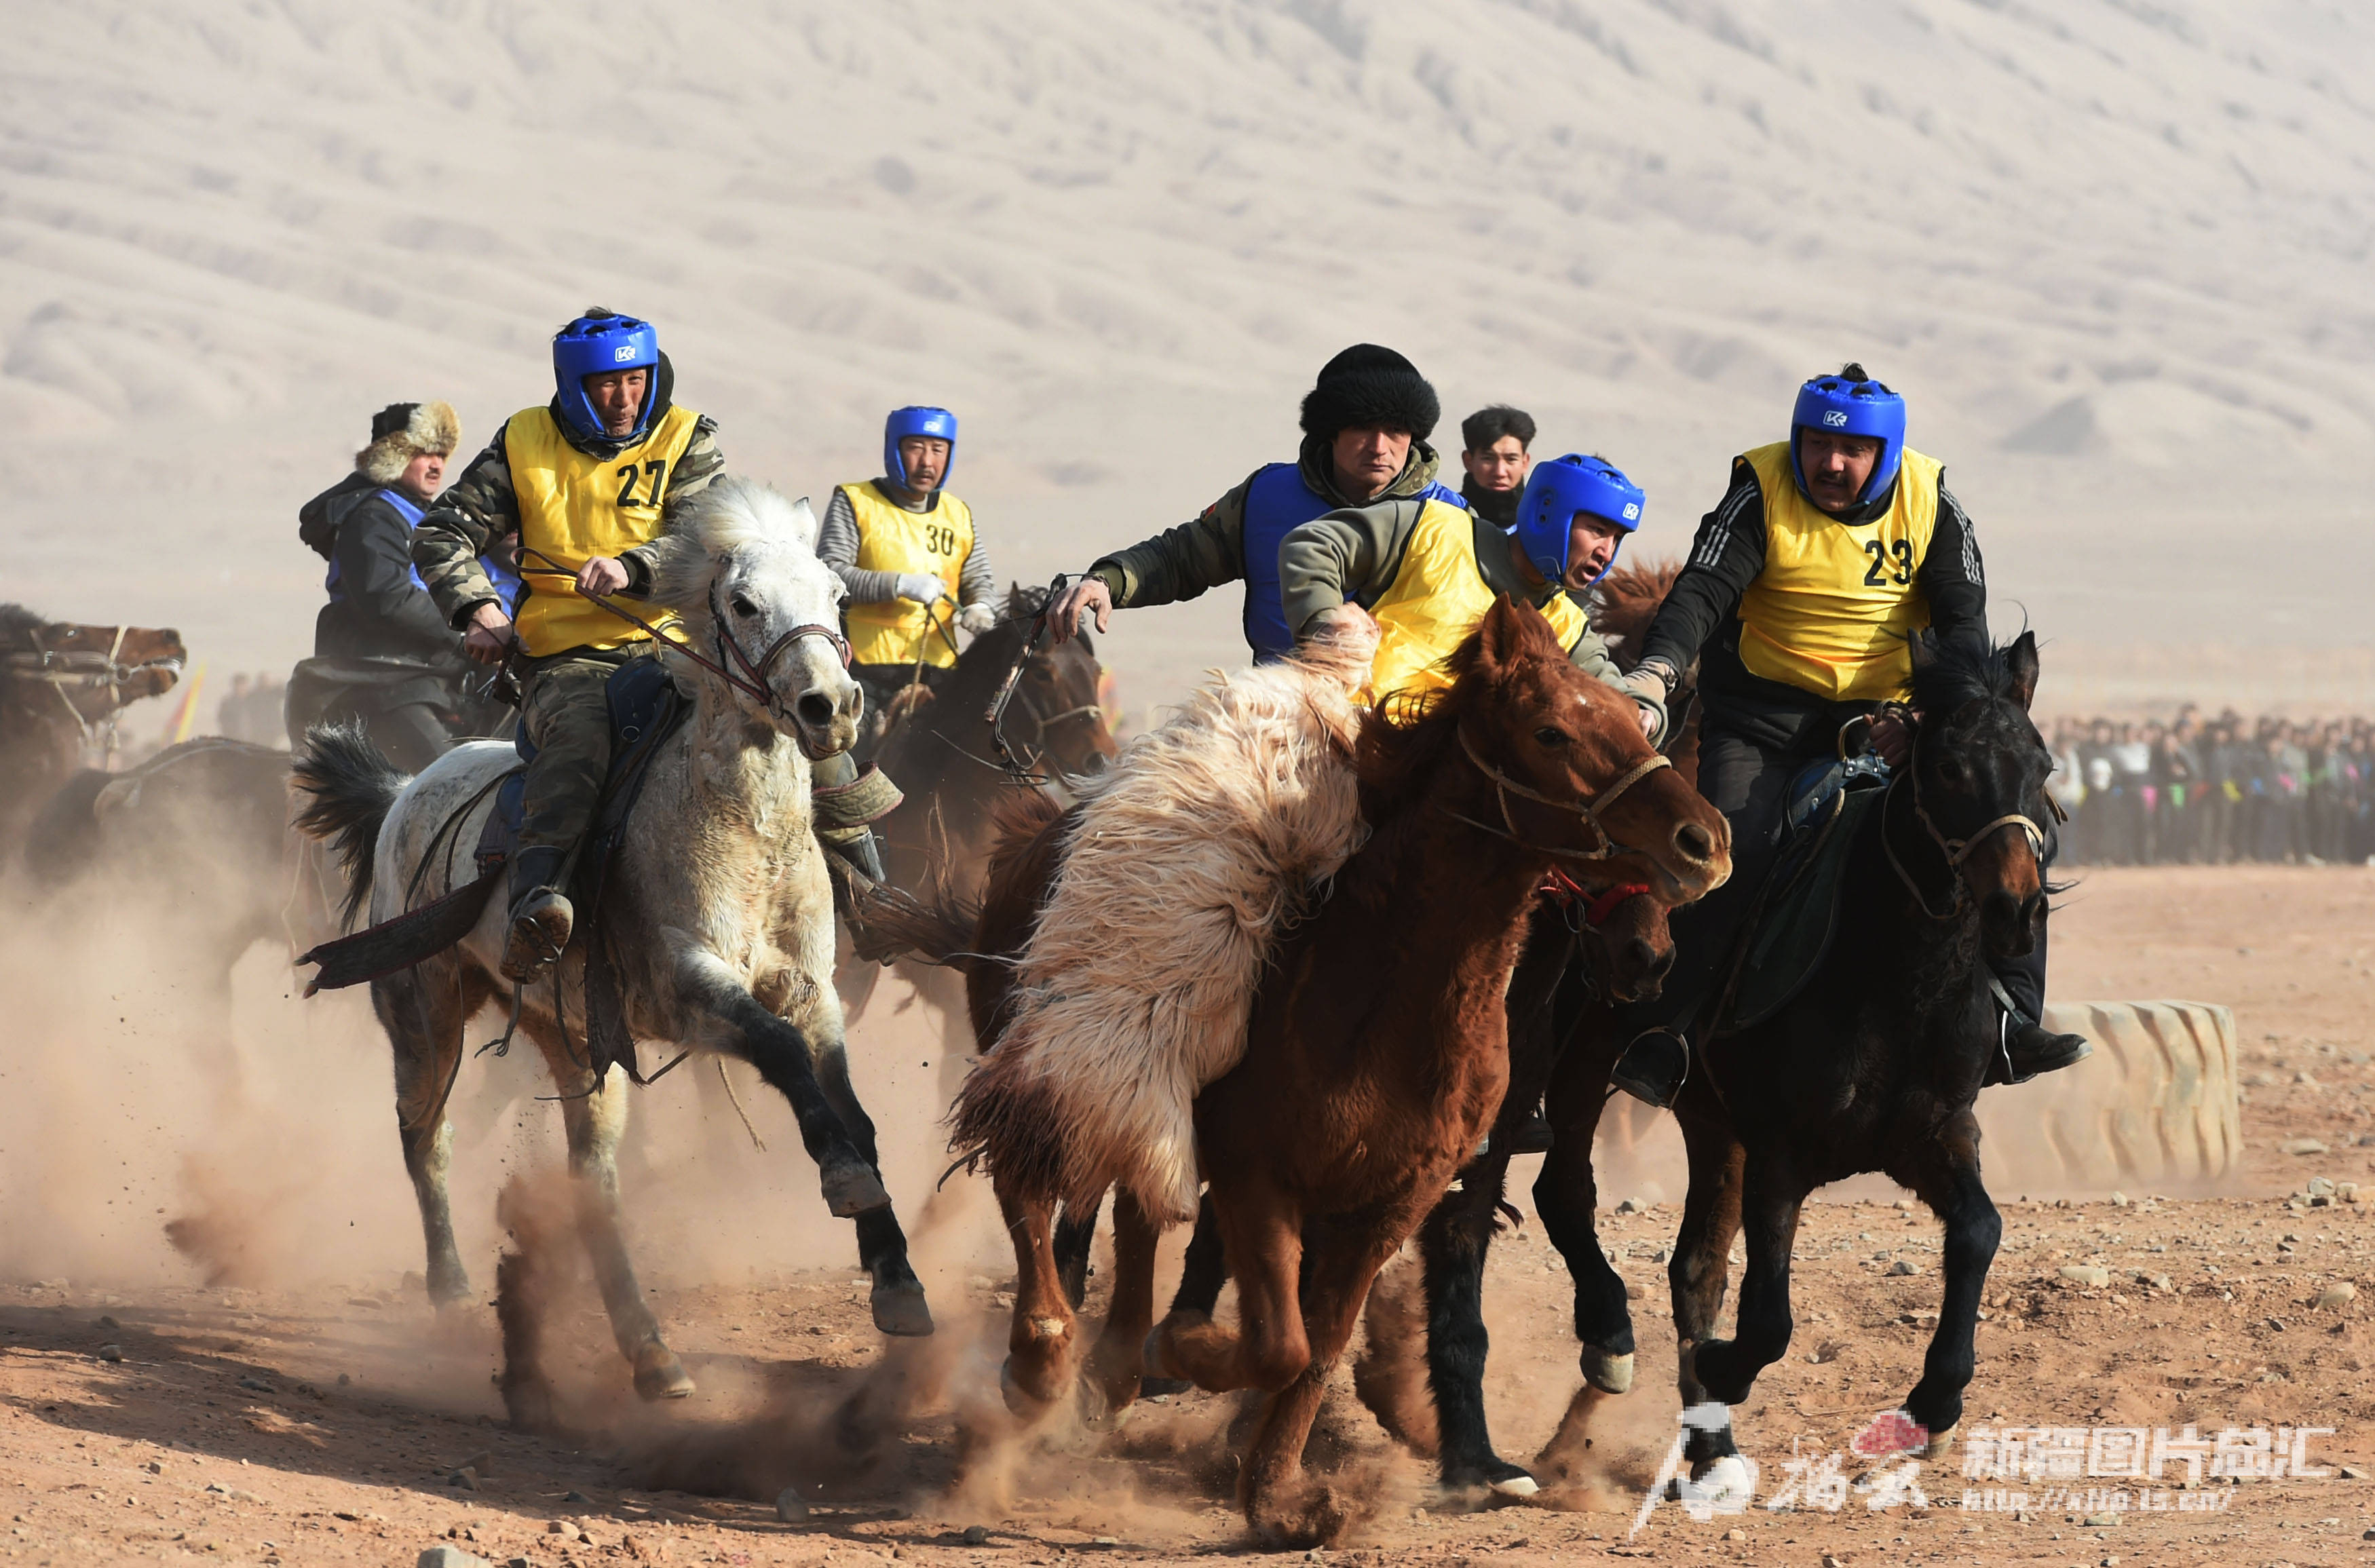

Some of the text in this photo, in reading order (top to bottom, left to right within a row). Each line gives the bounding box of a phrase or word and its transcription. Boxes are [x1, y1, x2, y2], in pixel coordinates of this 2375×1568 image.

[616, 459, 666, 508] 27
[926, 524, 954, 556] 30
[1863, 539, 1912, 586] 23
